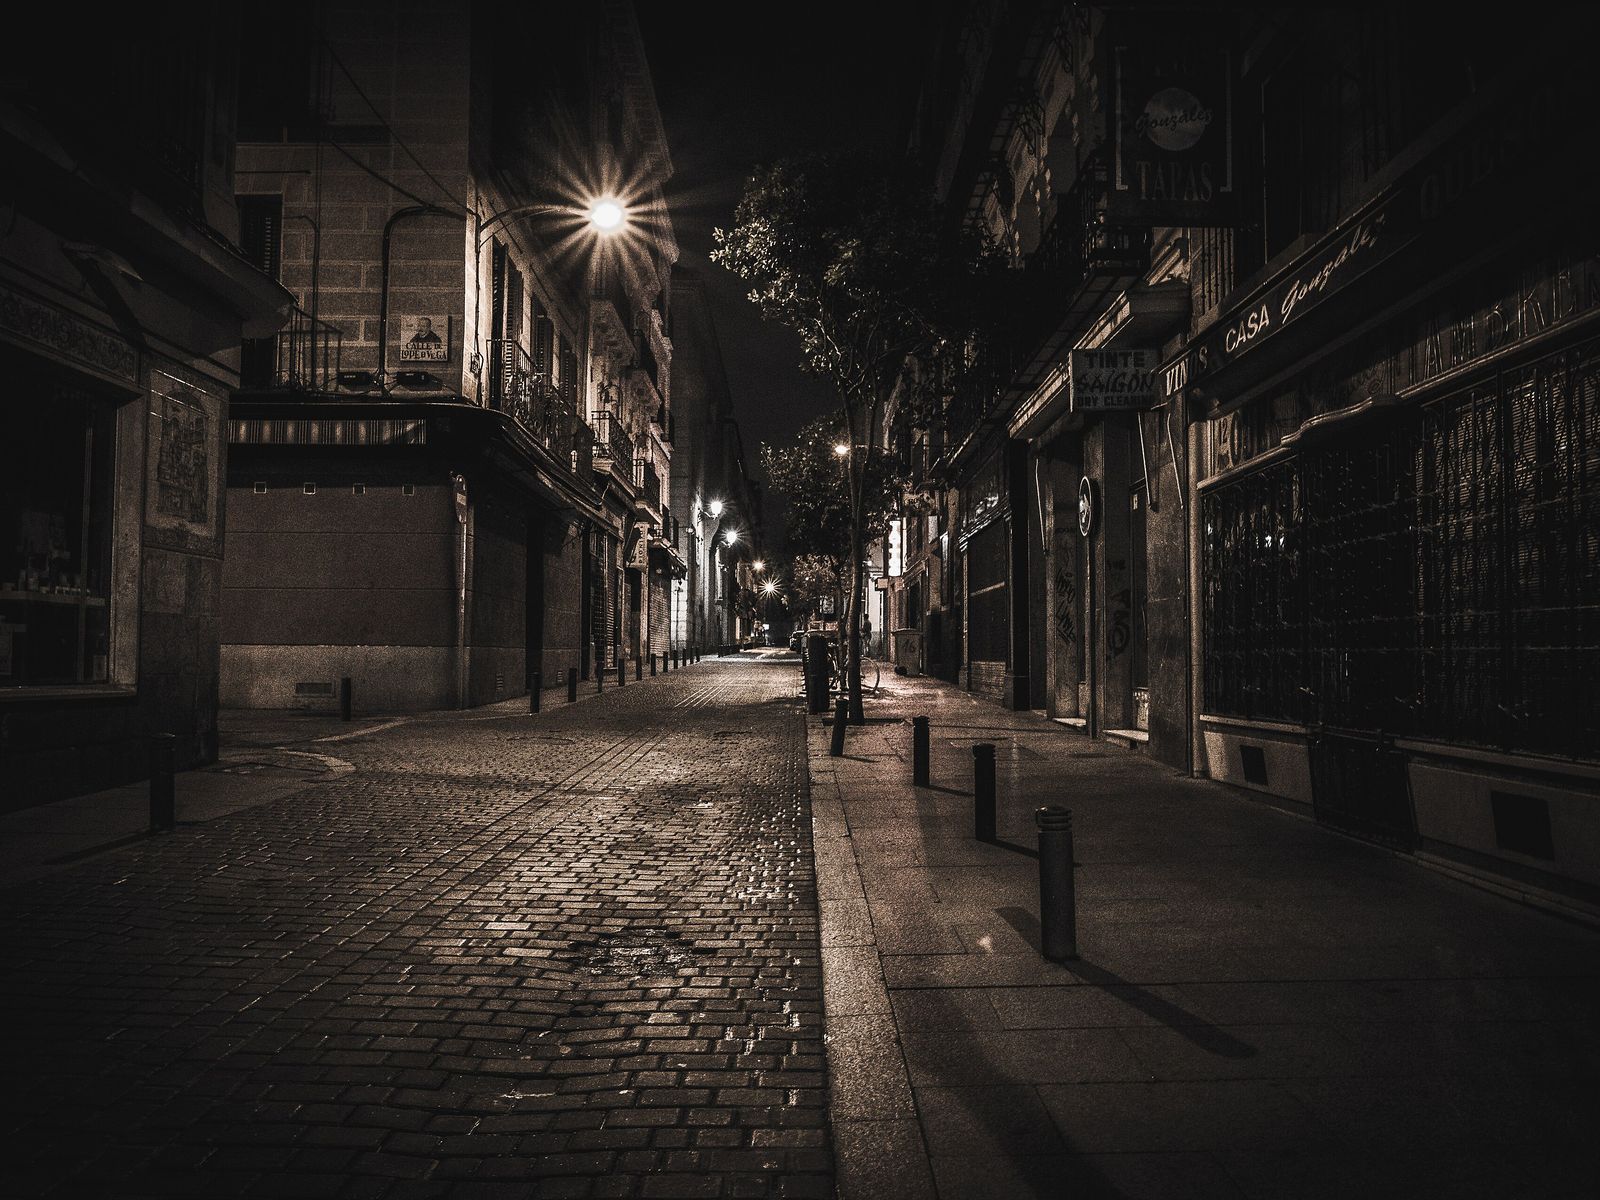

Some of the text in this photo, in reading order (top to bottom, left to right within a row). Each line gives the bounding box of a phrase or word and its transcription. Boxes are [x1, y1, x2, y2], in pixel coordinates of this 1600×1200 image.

[1136, 160, 1213, 203] TAPAS
[405, 342, 432, 350] CALLE
[1166, 343, 1208, 397] VINOS
[1225, 303, 1270, 353] CASA
[1084, 351, 1146, 369] TINTE
[1077, 396, 1098, 407] DRY
[1219, 417, 1228, 445] 12
